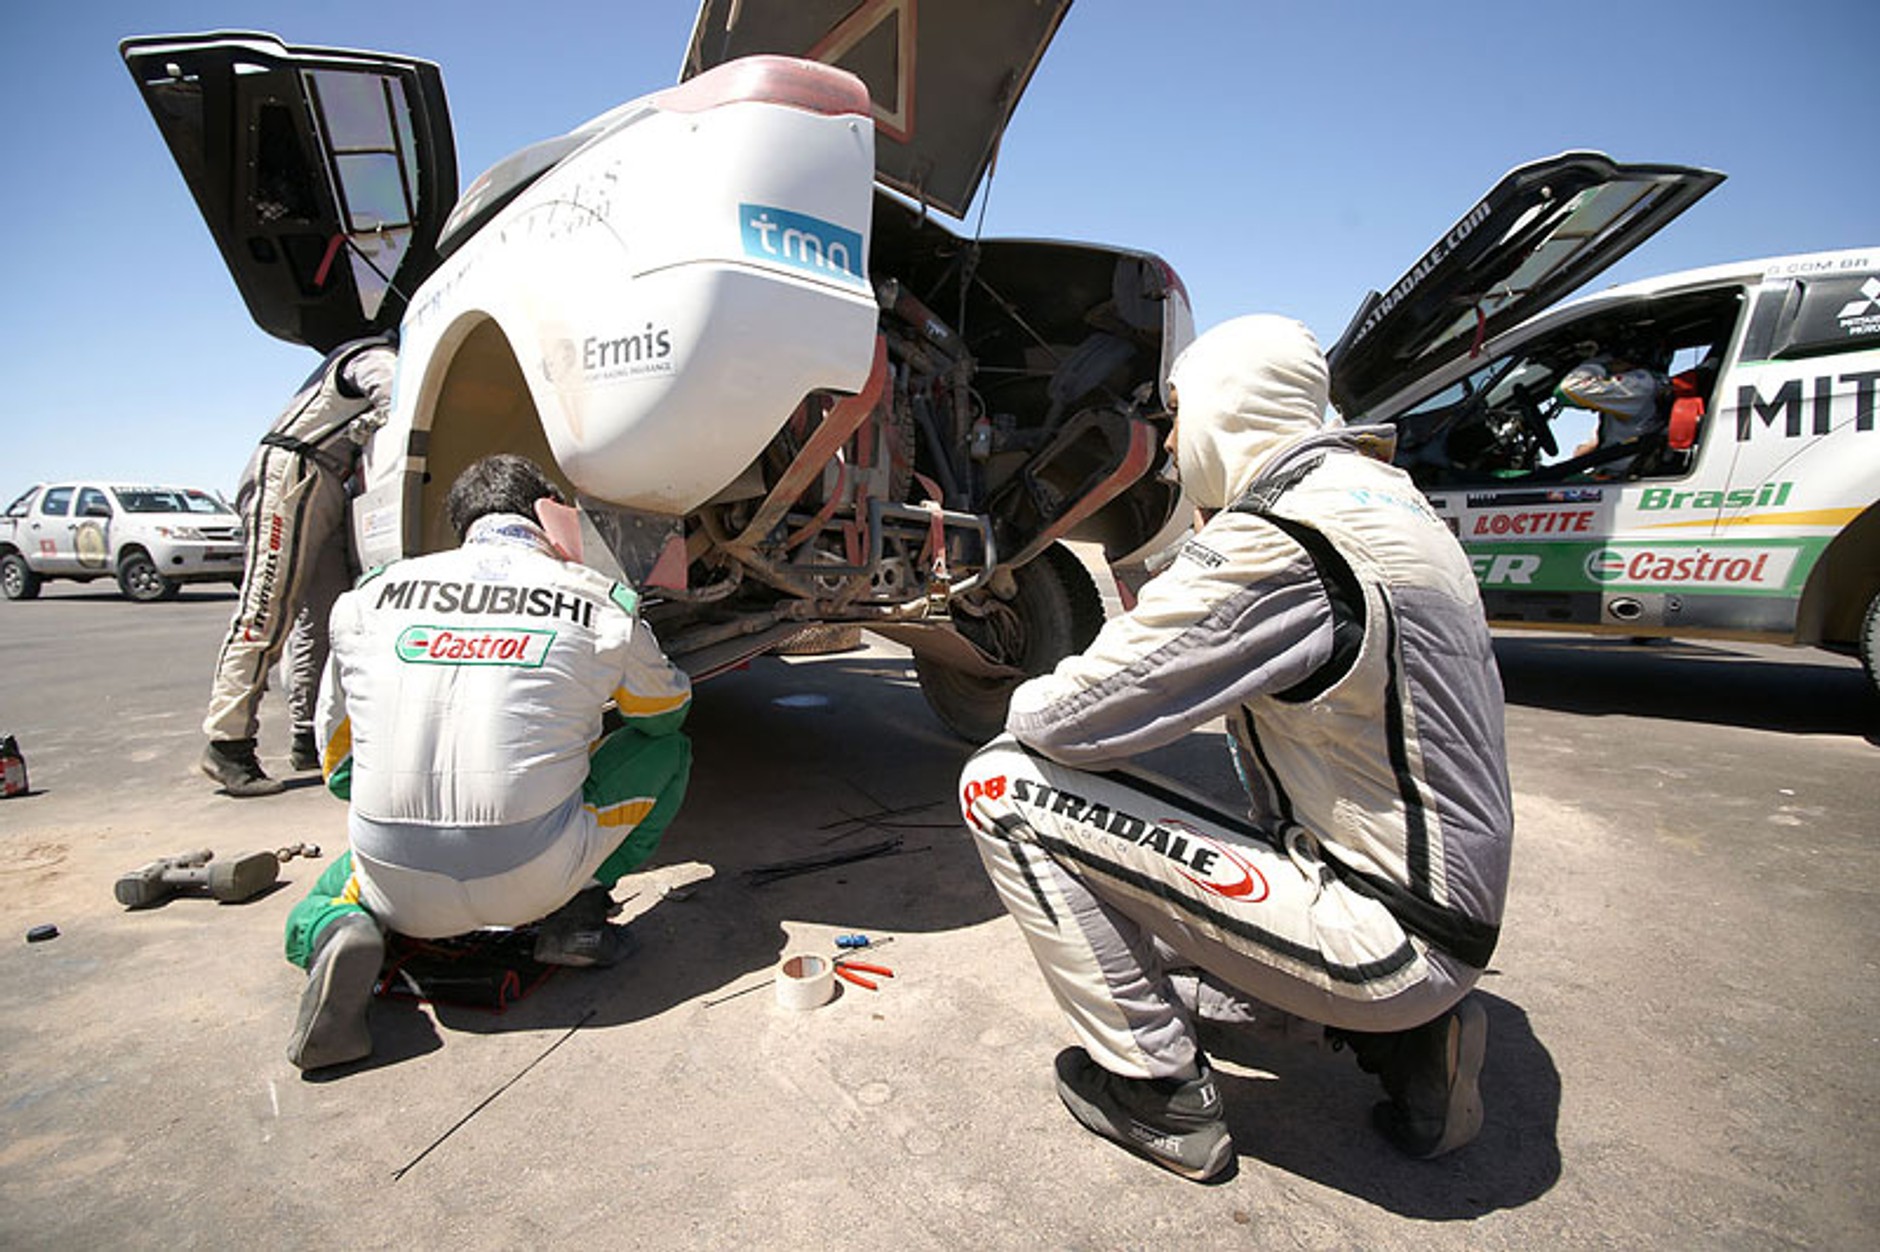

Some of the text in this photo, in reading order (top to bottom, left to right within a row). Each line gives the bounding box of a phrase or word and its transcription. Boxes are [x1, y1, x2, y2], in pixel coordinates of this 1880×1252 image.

[750, 213, 851, 277] tmn
[583, 322, 671, 370] Ermis
[1736, 370, 1880, 443] MIT
[1637, 482, 1794, 511] Brasil
[1473, 510, 1595, 535] LOCTITE
[1466, 554, 1542, 584] ER
[1627, 550, 1769, 583] Castrol
[375, 580, 593, 627] MITSUBISHI
[428, 631, 530, 661] Castrol
[1010, 778, 1220, 876] STRADALE
